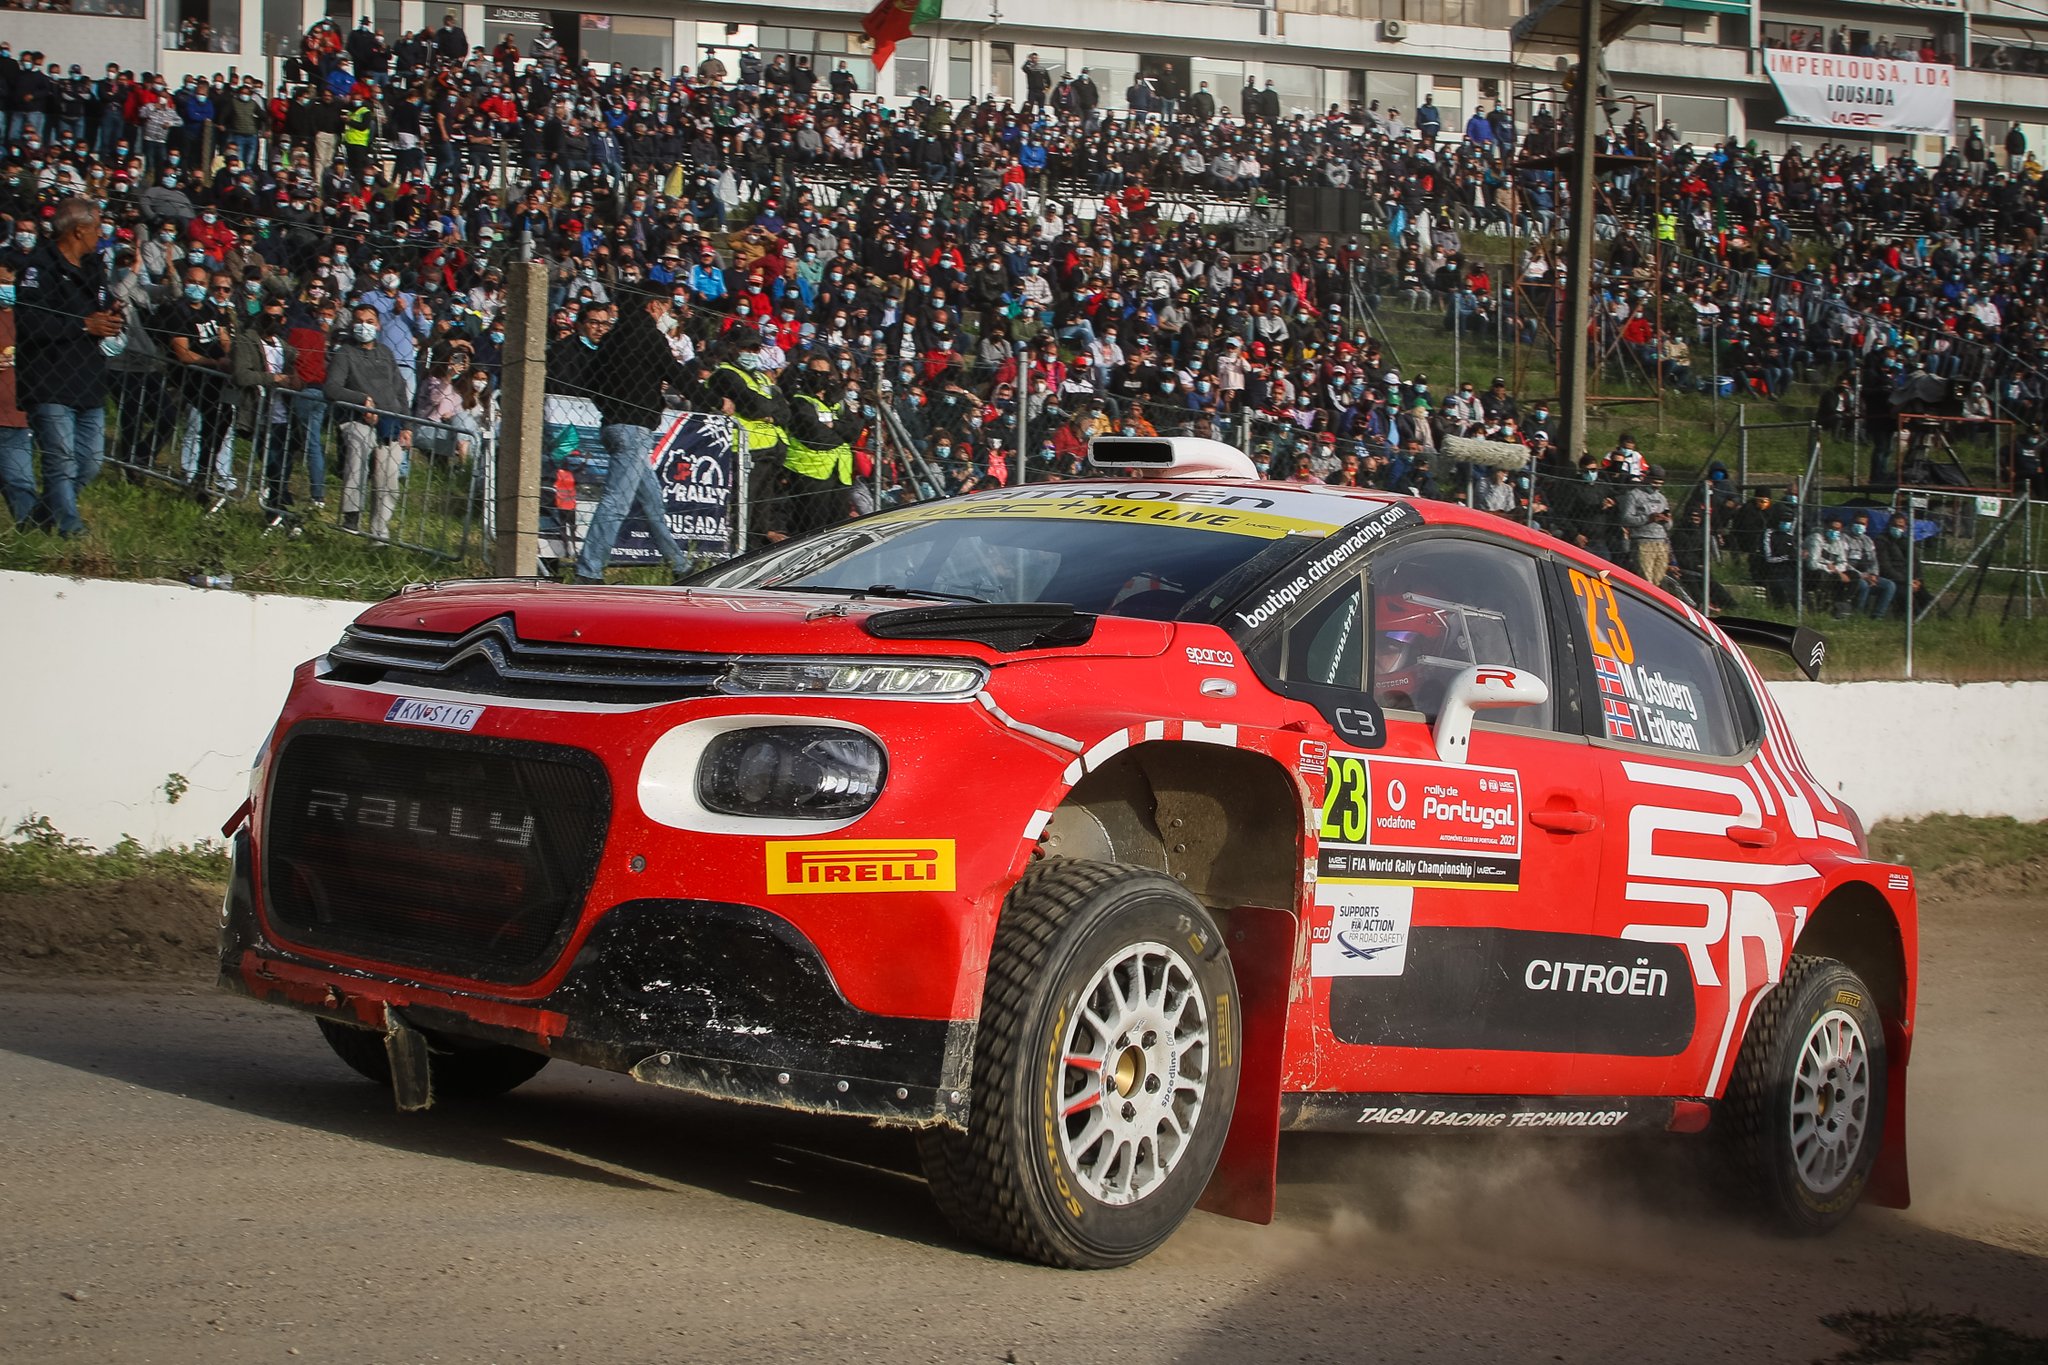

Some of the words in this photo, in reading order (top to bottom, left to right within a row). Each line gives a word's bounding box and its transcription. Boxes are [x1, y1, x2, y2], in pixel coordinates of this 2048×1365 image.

[1915, 66, 1950, 87] LDA
[1827, 84, 1895, 106] LOUSADA
[674, 484, 731, 506] RALLY
[663, 514, 729, 536] OUSADA
[1075, 504, 1142, 517] ALL
[1150, 509, 1239, 526] LIVE
[1236, 505, 1407, 629] boutique.citroenracing.com
[1568, 568, 1635, 665] 23
[1185, 646, 1233, 665] sparco
[1616, 661, 1643, 699] M.
[1637, 664, 1698, 721] Østberg
[1335, 707, 1377, 737] C3
[1628, 703, 1649, 742] T.
[1646, 706, 1700, 752] Eriksen
[1300, 739, 1328, 760] C3
[1319, 755, 1367, 842] 23
[1424, 785, 1445, 798] rally
[1445, 786, 1459, 797] de
[1376, 815, 1416, 830] vodafone
[1423, 797, 1515, 829] Portugal
[1499, 834, 1516, 846] 2021
[786, 849, 938, 883] PIRELLI
[1352, 857, 1366, 871] FIA
[1369, 859, 1393, 873] World
[1395, 859, 1416, 875] Rally
[1418, 860, 1472, 878] Championship
[1340, 905, 1379, 918] SUPPORTS
[1363, 919, 1394, 932] ACTION
[1349, 933, 1359, 941] FOR
[1359, 933, 1378, 944] ROAD
[1379, 933, 1404, 944] SAFETY
[1835, 990, 1862, 1007] PIRELLI
[1216, 993, 1232, 1069] PIRELLI
[1161, 1050, 1177, 1108] speedline
[1357, 1107, 1426, 1124] TAGAI
[1422, 1111, 1507, 1128] RACING
[1507, 1111, 1629, 1128] TECHNOLOGY
